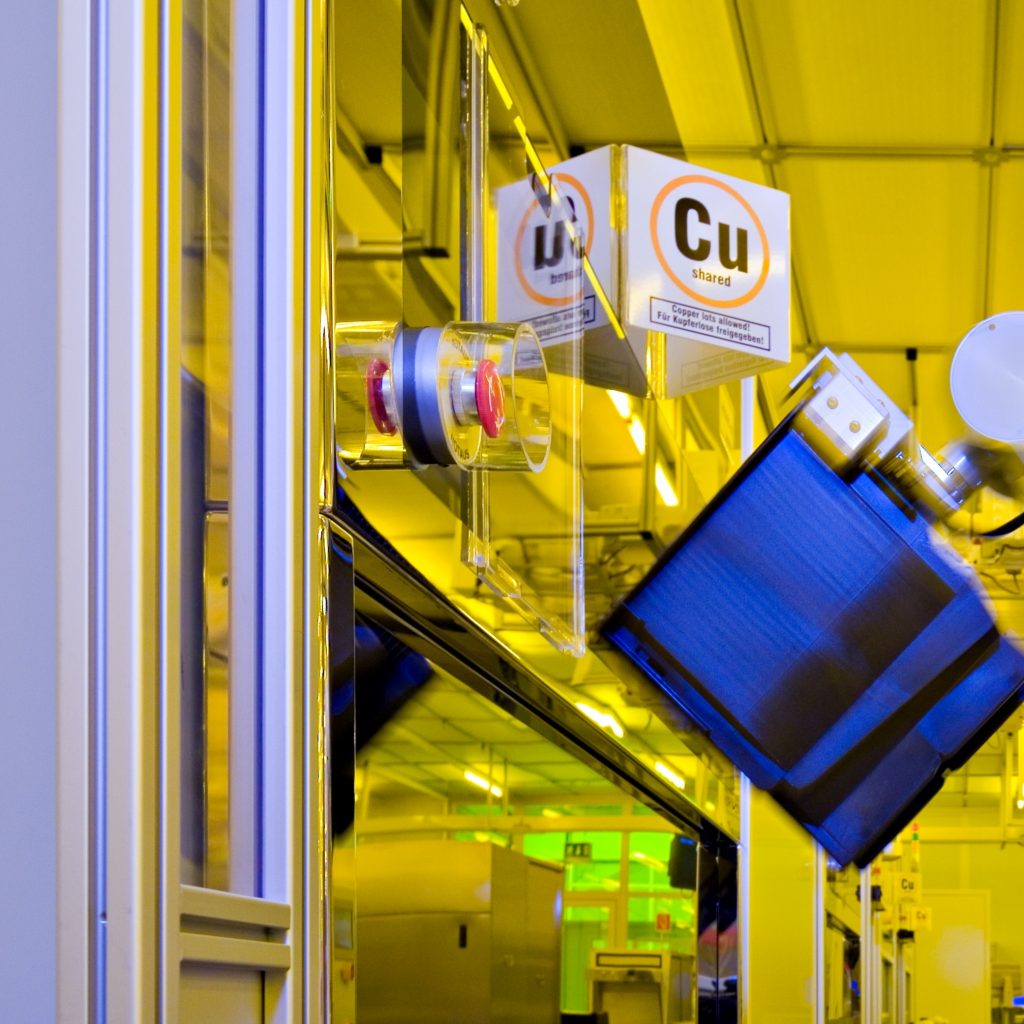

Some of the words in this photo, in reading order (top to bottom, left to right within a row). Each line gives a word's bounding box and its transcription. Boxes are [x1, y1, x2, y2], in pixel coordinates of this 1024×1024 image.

[674, 196, 749, 274] Cu
[691, 268, 731, 287] shared
[657, 310, 670, 322] Für
[673, 315, 714, 332] Kupferlose
[716, 325, 765, 345] freigegeben!
[671, 304, 700, 318] Copper
[702, 311, 716, 323] lots
[718, 317, 751, 332] allowed!
[901, 878, 915, 890] Cu
